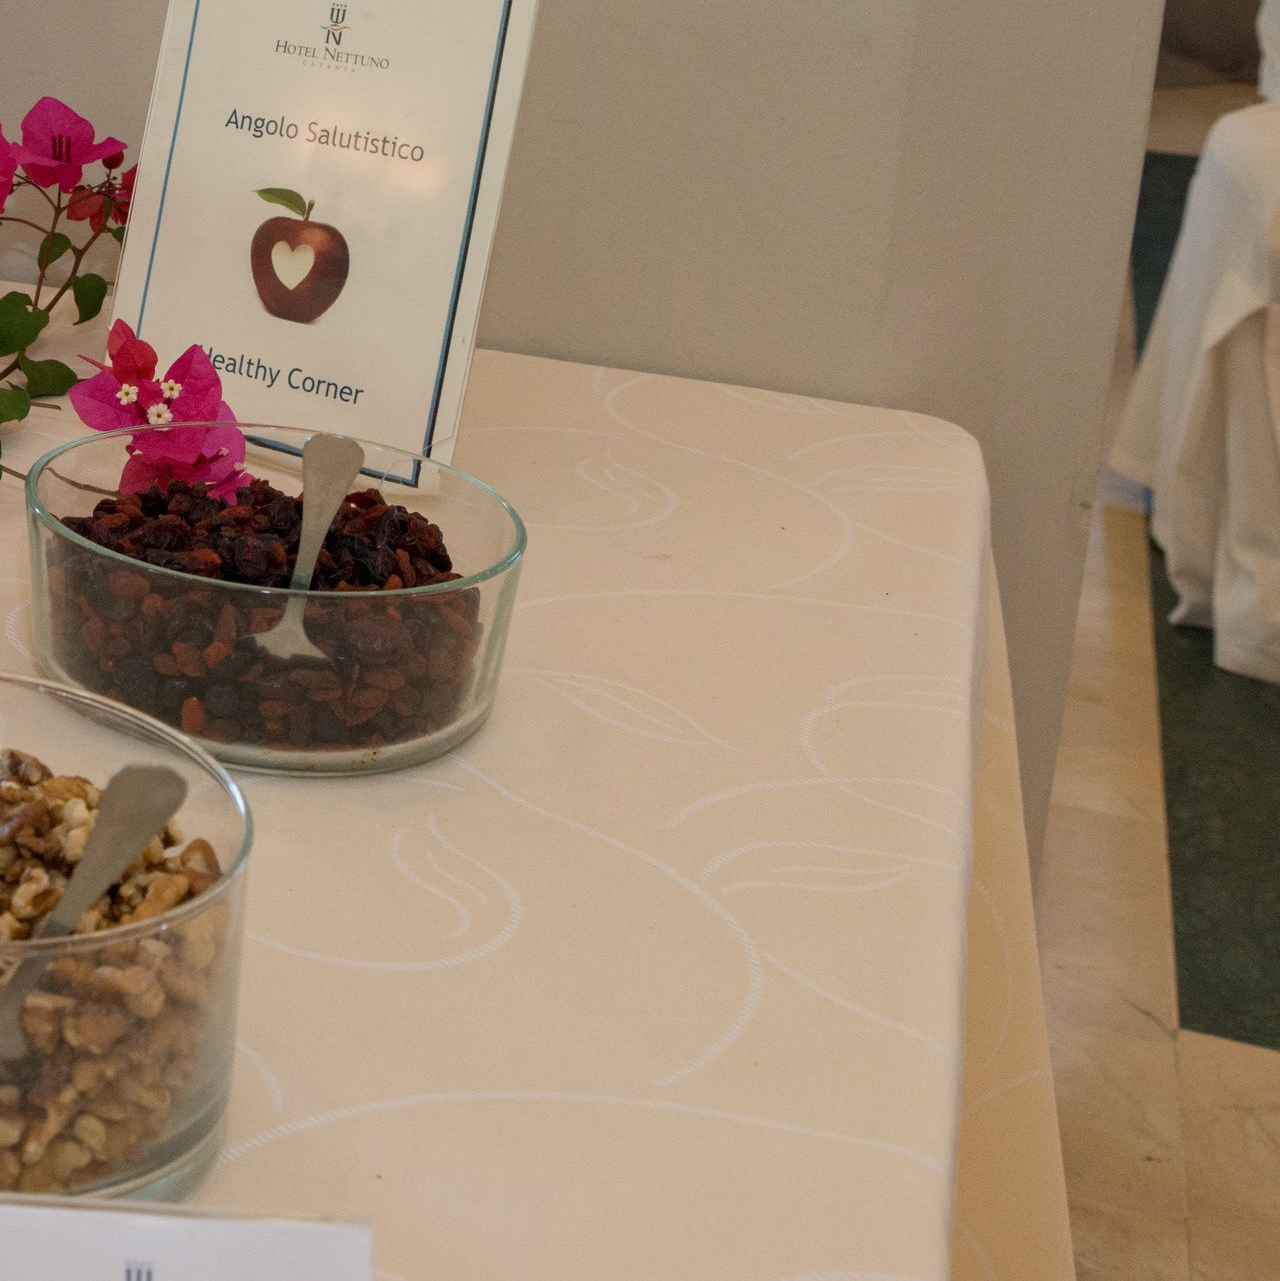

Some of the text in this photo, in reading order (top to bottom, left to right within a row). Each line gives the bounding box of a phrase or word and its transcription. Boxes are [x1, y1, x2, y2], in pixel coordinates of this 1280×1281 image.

[275, 39, 390, 70] HOTEL NETTUNO
[225, 108, 425, 162] Angolo Salutistico
[287, 367, 365, 405] Corner
